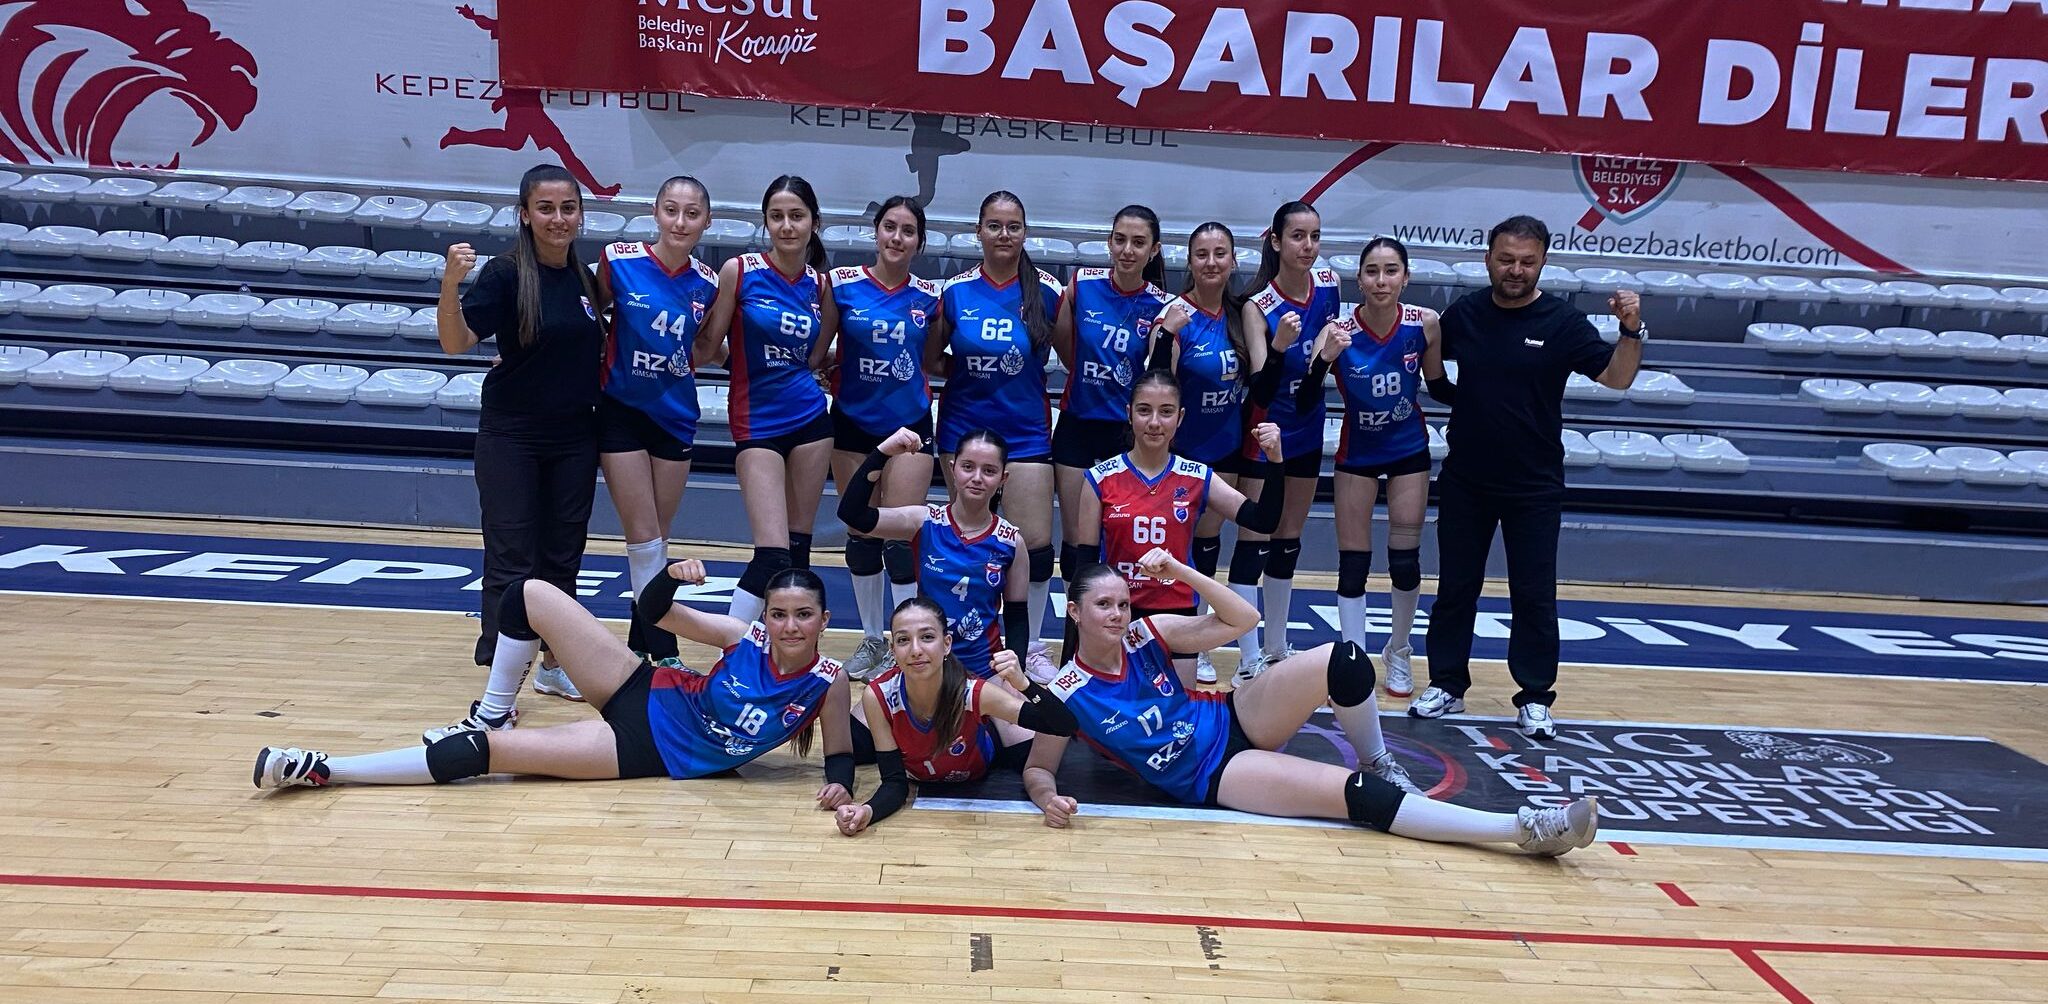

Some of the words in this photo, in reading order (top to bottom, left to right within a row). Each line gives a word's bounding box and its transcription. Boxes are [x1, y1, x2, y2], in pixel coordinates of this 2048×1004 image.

[638, 15, 705, 40] Belediye
[638, 33, 703, 52] Başkanı
[714, 20, 818, 64] Kocagöz
[918, 0, 1660, 122] BAŞARILAR
[1698, 22, 2048, 144] DİLER
[375, 72, 501, 100] KEPEZ
[790, 105, 909, 132] KEPEZ
[1592, 171, 1661, 186] BELEDİYESİ
[1607, 187, 1641, 205] S.K.
[613, 243, 639, 254] 1922
[836, 268, 859, 281] 1922
[1317, 269, 1335, 283] GSK
[651, 310, 687, 341] 44
[780, 311, 812, 339] 63
[1404, 308, 1423, 321] GSK
[872, 319, 906, 345] 24
[981, 318, 1013, 341] 62
[1101, 323, 1131, 353] 78
[633, 350, 667, 371] RZ
[859, 357, 890, 376] RZ
[966, 356, 998, 371] RZ
[1083, 361, 1112, 380] RZ
[1219, 349, 1239, 375] 15
[1371, 371, 1401, 398] 88
[1202, 389, 1230, 406] RZ
[1359, 410, 1390, 426] RZ
[1094, 459, 1119, 475] 1922
[1180, 461, 1203, 474] GSK
[997, 524, 1019, 542] GSK
[1133, 515, 1167, 545] 66
[951, 576, 970, 602] 4
[819, 660, 843, 678] GSK
[1055, 670, 1082, 692] 1922
[735, 702, 768, 736] 18
[1137, 704, 1164, 737] 17
[1444, 724, 1713, 757] ING
[1146, 740, 1177, 771] RZ
[1475, 752, 1897, 787] KADINLAR
[1498, 772, 2001, 812] BASKETBOL
